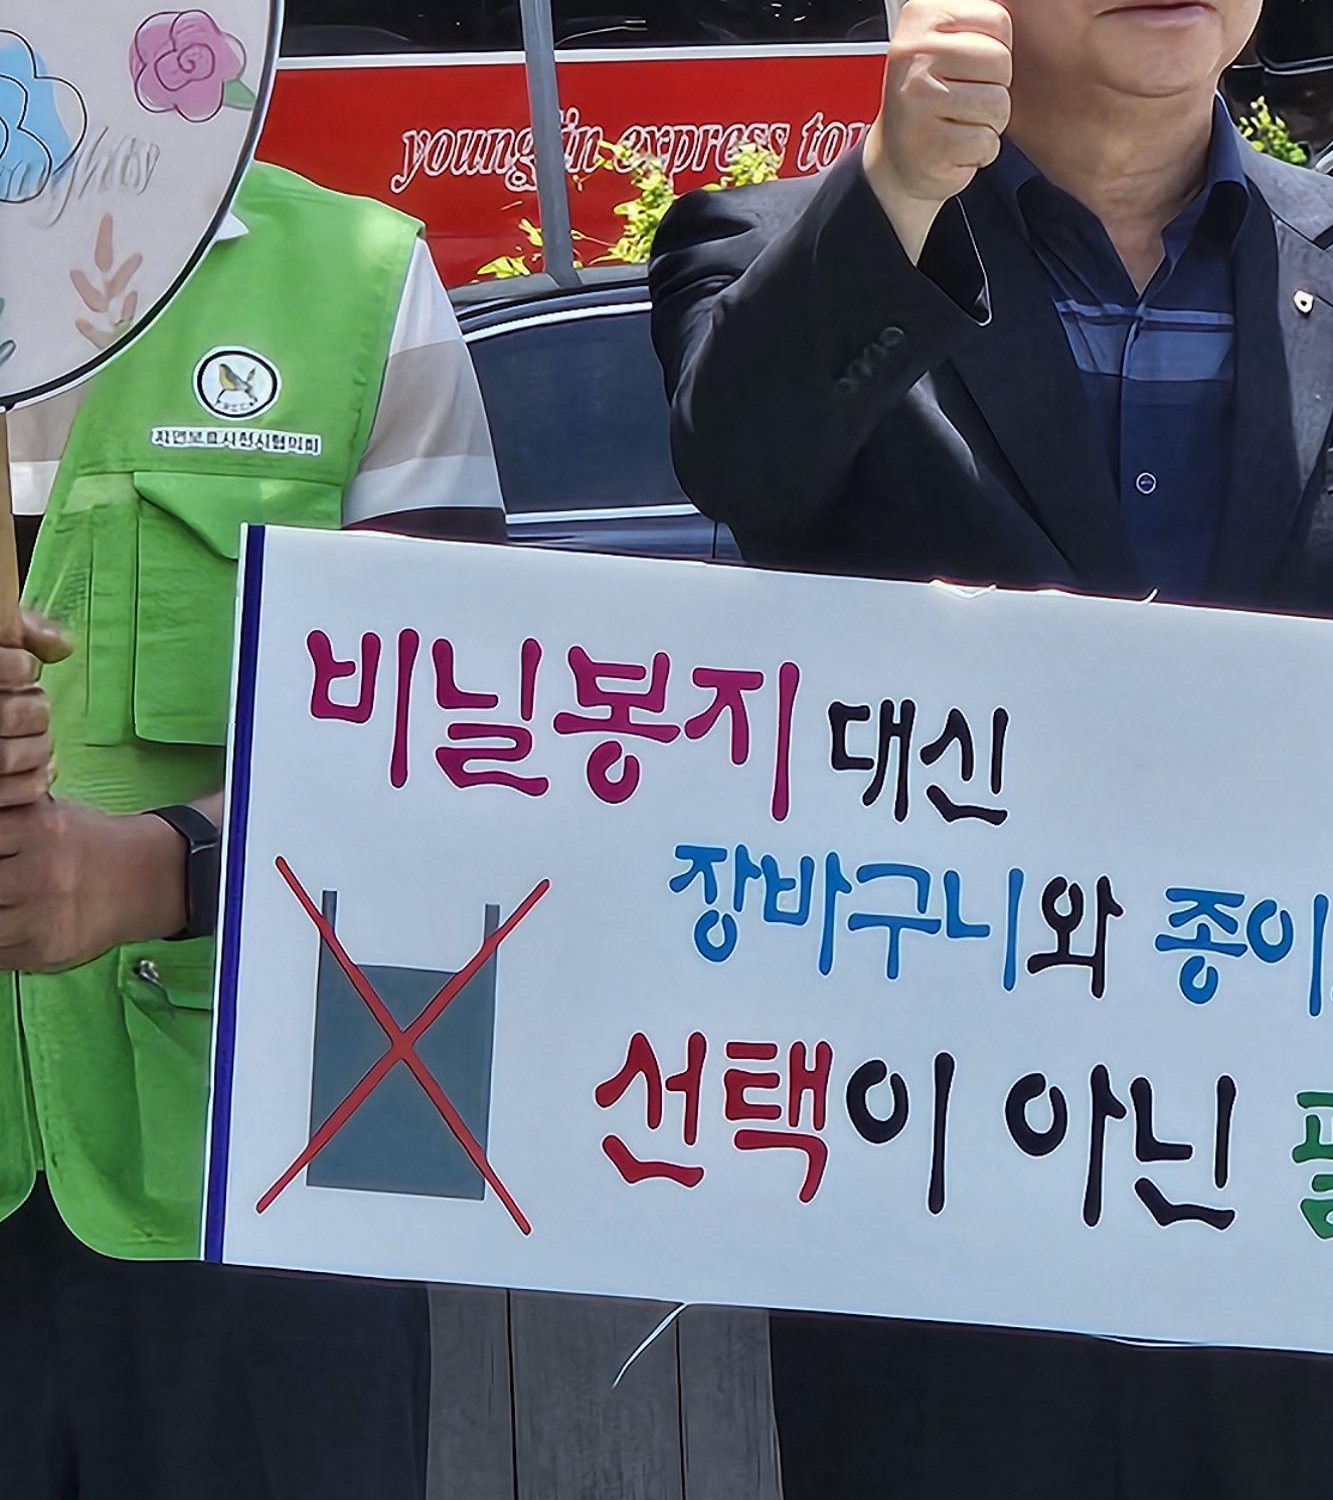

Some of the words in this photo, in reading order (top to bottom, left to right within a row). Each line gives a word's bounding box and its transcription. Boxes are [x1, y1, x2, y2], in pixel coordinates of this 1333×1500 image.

[389, 106, 604, 193] youngin
[306, 628, 801, 823] 비닐봉지
[827, 698, 1008, 825] 대신
[668, 841, 1123, 999] 장바구니와
[594, 1030, 956, 1217] 선택이
[1003, 1062, 1237, 1230] 아닌
